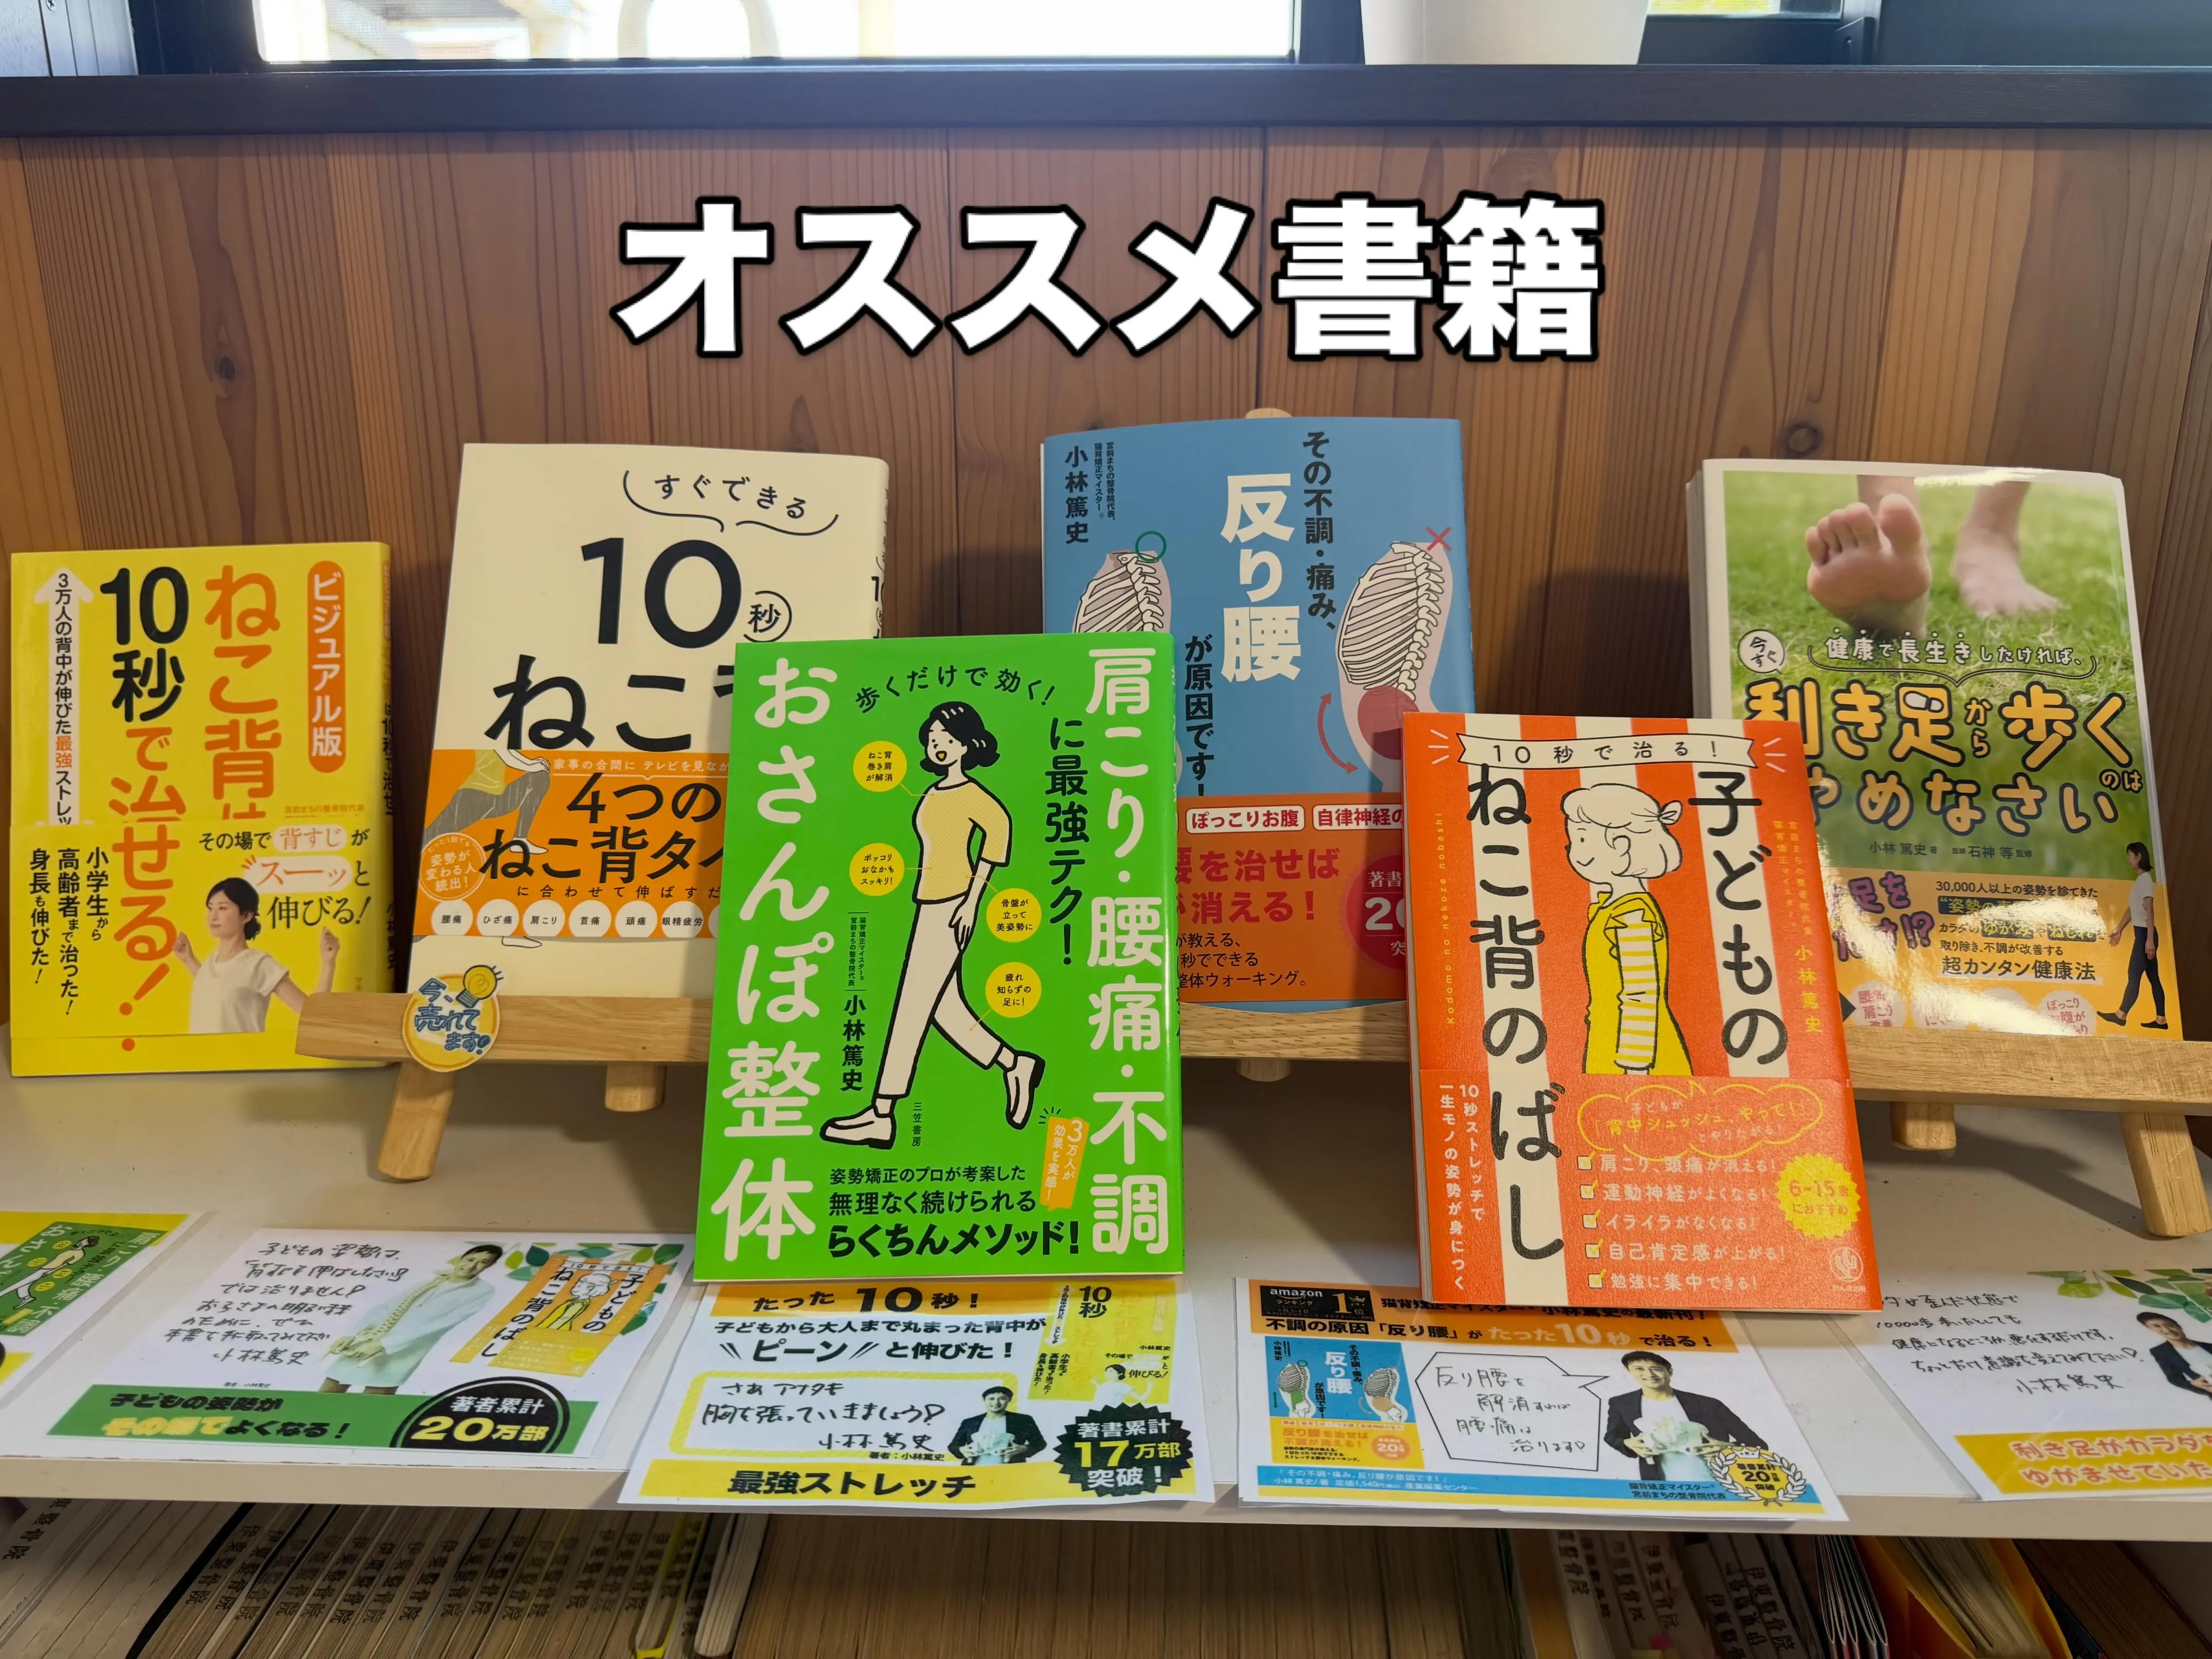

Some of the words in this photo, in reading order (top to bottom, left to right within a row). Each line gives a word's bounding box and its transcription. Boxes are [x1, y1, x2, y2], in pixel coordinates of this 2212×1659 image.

[655, 475, 807, 520] すぐできる
[1065, 446, 1088, 544] 小林篤史
[1303, 431, 1337, 630] その不調・痛み、
[1220, 473, 1301, 682] 反り腰
[1750, 637, 1766, 651] 今
[1826, 637, 2081, 665] 健康で長生きしたければ、
[311, 572, 343, 757] ビジュアル版
[1751, 651, 1777, 669] すぐ
[204, 565, 282, 820] ねこ背
[855, 665, 1057, 714] 歩くだけで効く！
[485, 654, 736, 753] ねこ
[554, 758, 636, 771] 家事の合間に
[867, 750, 893, 761] ねこ背
[1492, 740, 1717, 765] 10秒で治る！
[865, 773, 893, 783] が解消
[866, 762, 893, 772] 巻き肩
[2100, 770, 2143, 792] のは
[568, 772, 721, 824] 4つの
[1192, 809, 1299, 828] ぽっこりお腹
[1044, 717, 1089, 966] に最強テク！
[1434, 812, 1446, 870] nobashi
[860, 865, 895, 875] おなかも
[864, 853, 893, 864] ポッコリ
[860, 876, 894, 886] スッキリ！
[1936, 881, 2098, 898] 30,000人以上の姿勢を診てきた
[87, 847, 109, 941] 小学生から
[1001, 898, 1029, 908] 骨盤が
[1439, 878, 1449, 930] nekoze
[29, 848, 51, 984] 身長も伸びた！
[267, 895, 371, 929] 伸びる！
[441, 915, 462, 924] 腰痛
[483, 915, 512, 925] ひざ痛
[530, 915, 557, 925] 肩こり
[580, 916, 601, 926] 首痛
[626, 916, 646, 926] 頭痛
[662, 916, 703, 927] 眼精疲労
[1002, 911, 1027, 921] 立って
[1688, 771, 1789, 1065] 子どもの
[58, 847, 80, 1015] 高齢者まで治った！
[996, 922, 1034, 933] 美姿勢に
[711, 657, 838, 1262] おさんぽ整体
[847, 916, 858, 987] 宮前まちの整骨院代表
[1085, 648, 1171, 1256] 肩こり・腰痛・不調
[1444, 939, 1451, 955] no
[1940, 941, 2063, 956] 取り除き、不調が改善する
[1005, 972, 1024, 983] 疲れ
[1941, 956, 2096, 981] 超カンタン健康法
[419, 978, 454, 1003] 今、
[996, 984, 1032, 995] 知らずの
[1795, 945, 1823, 1035] 小林篤史
[1002, 997, 1026, 1008] 足に！
[1466, 763, 1564, 1260] ねこ背のばし
[415, 1004, 481, 1032] 売れて
[840, 994, 867, 1091] 小林篤史
[911, 1102, 923, 1148] 三笠書房
[1044, 1124, 1066, 1202] 効果を実感！
[1062, 1120, 1084, 1182] 3万人が
[1459, 1084, 1485, 1222] 10秒ストレッチで
[830, 1165, 1027, 1185] 姿勢矯正のプロが考案した
[1438, 1084, 1466, 1290] 一生モノの姿勢が身につく
[828, 1190, 1037, 1217] 無理なく続けられる
[1602, 1182, 1768, 1203] 運動神経がよくなる！
[827, 1220, 1081, 1259] らくちんメソッド！
[1608, 1242, 1785, 1262] 自己肯定感が上がる！
[1270, 1288, 1323, 1298] amazon
[1610, 1272, 1757, 1291] 勉強に集中できる！
[481, 1267, 573, 1357] ねこ背のばし
[583, 1273, 644, 1332] 子どもの
[753, 1287, 979, 1312] たった10秒！
[1079, 1285, 1112, 1318] 10秒
[714, 1318, 1047, 1334] 子どもから大人まで丸まった背中が
[1325, 1351, 1353, 1394] 反り腰
[721, 1383, 763, 1395] さあ
[450, 1396, 545, 1415] 著者累計
[410, 1416, 550, 1442] 20万部
[1077, 1419, 1171, 1439] 著書累計
[818, 1432, 935, 1452] 小林篤史
[1074, 1439, 1181, 1468] 17万部
[727, 1470, 976, 1499] 最強ストレッチ
[1087, 1466, 1163, 1489] 突破！
